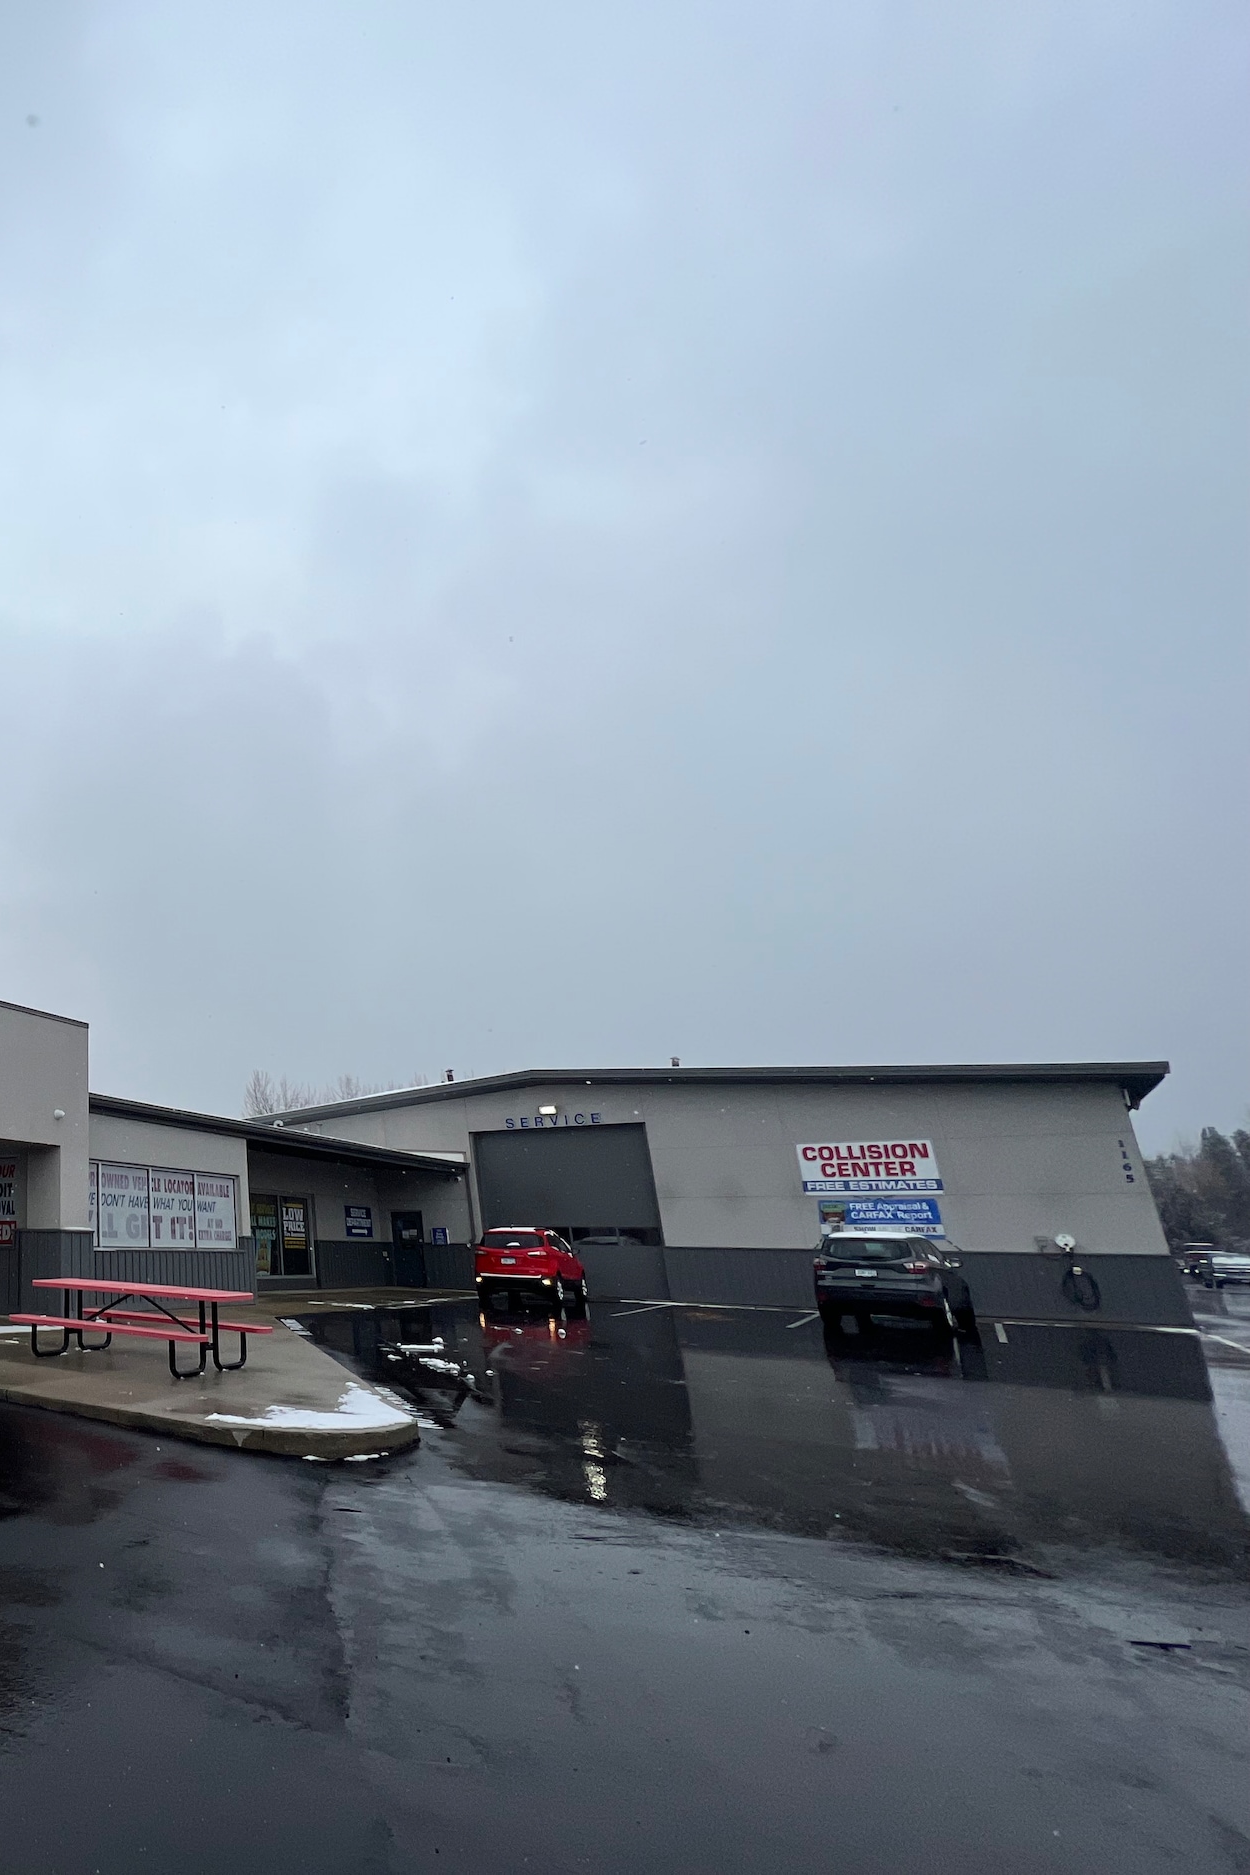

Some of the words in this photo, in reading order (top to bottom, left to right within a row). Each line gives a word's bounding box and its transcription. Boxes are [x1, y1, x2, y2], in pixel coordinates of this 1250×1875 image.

[505, 1113, 601, 1129] SERVICE
[802, 1143, 930, 1161] COLLISION
[1118, 1139, 1135, 1183] 1165
[820, 1161, 917, 1178] CENTER
[198, 1182, 230, 1198] AVAILABLE
[806, 1182, 846, 1191] FREE
[849, 1180, 938, 1191] ESTIMATES
[128, 1195, 149, 1210] HAVE
[153, 1197, 174, 1211] WHAT
[178, 1199, 194, 1212] YOU
[197, 1201, 216, 1213] WANT
[850, 1203, 875, 1211] FREE
[876, 1202, 921, 1213] Appraisal
[282, 1207, 304, 1221] LOW
[851, 1211, 894, 1220] CARFAX
[897, 1211, 933, 1221] Report
[283, 1220, 305, 1232] PRICE
